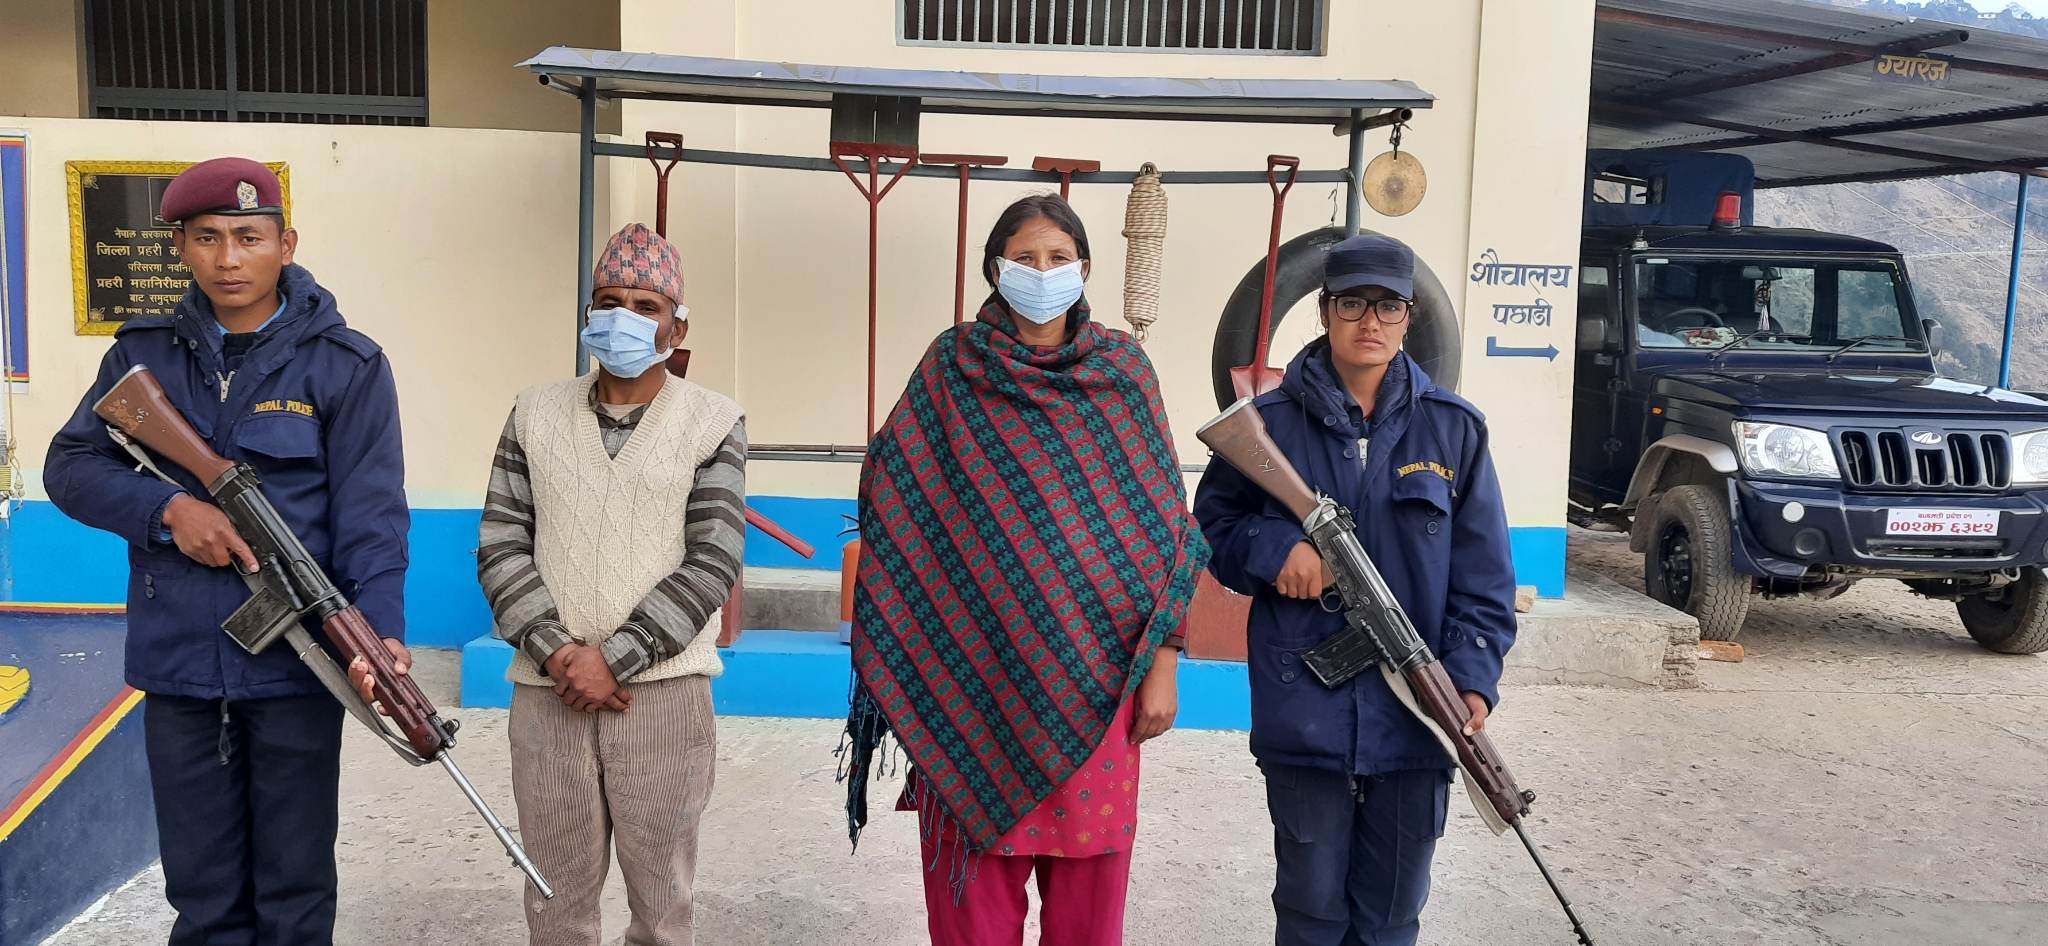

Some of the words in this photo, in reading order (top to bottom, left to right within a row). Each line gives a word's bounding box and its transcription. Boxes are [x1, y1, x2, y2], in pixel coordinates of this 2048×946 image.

[1877, 53, 1949, 81] ग्यारेज
[113, 227, 137, 238] नेपाल
[96, 241, 131, 256] जिल्ला
[137, 242, 162, 256] प्रहरी
[127, 261, 162, 273] परिसरमा
[1470, 248, 1573, 294] शौचालय
[96, 275, 123, 289] प्रहरी
[129, 293, 145, 303] बाट
[1492, 298, 1553, 327] पछाडी
[255, 400, 283, 412] NEPAL
[286, 400, 313, 416] POLICE
[1397, 461, 1428, 478] NEPAL
